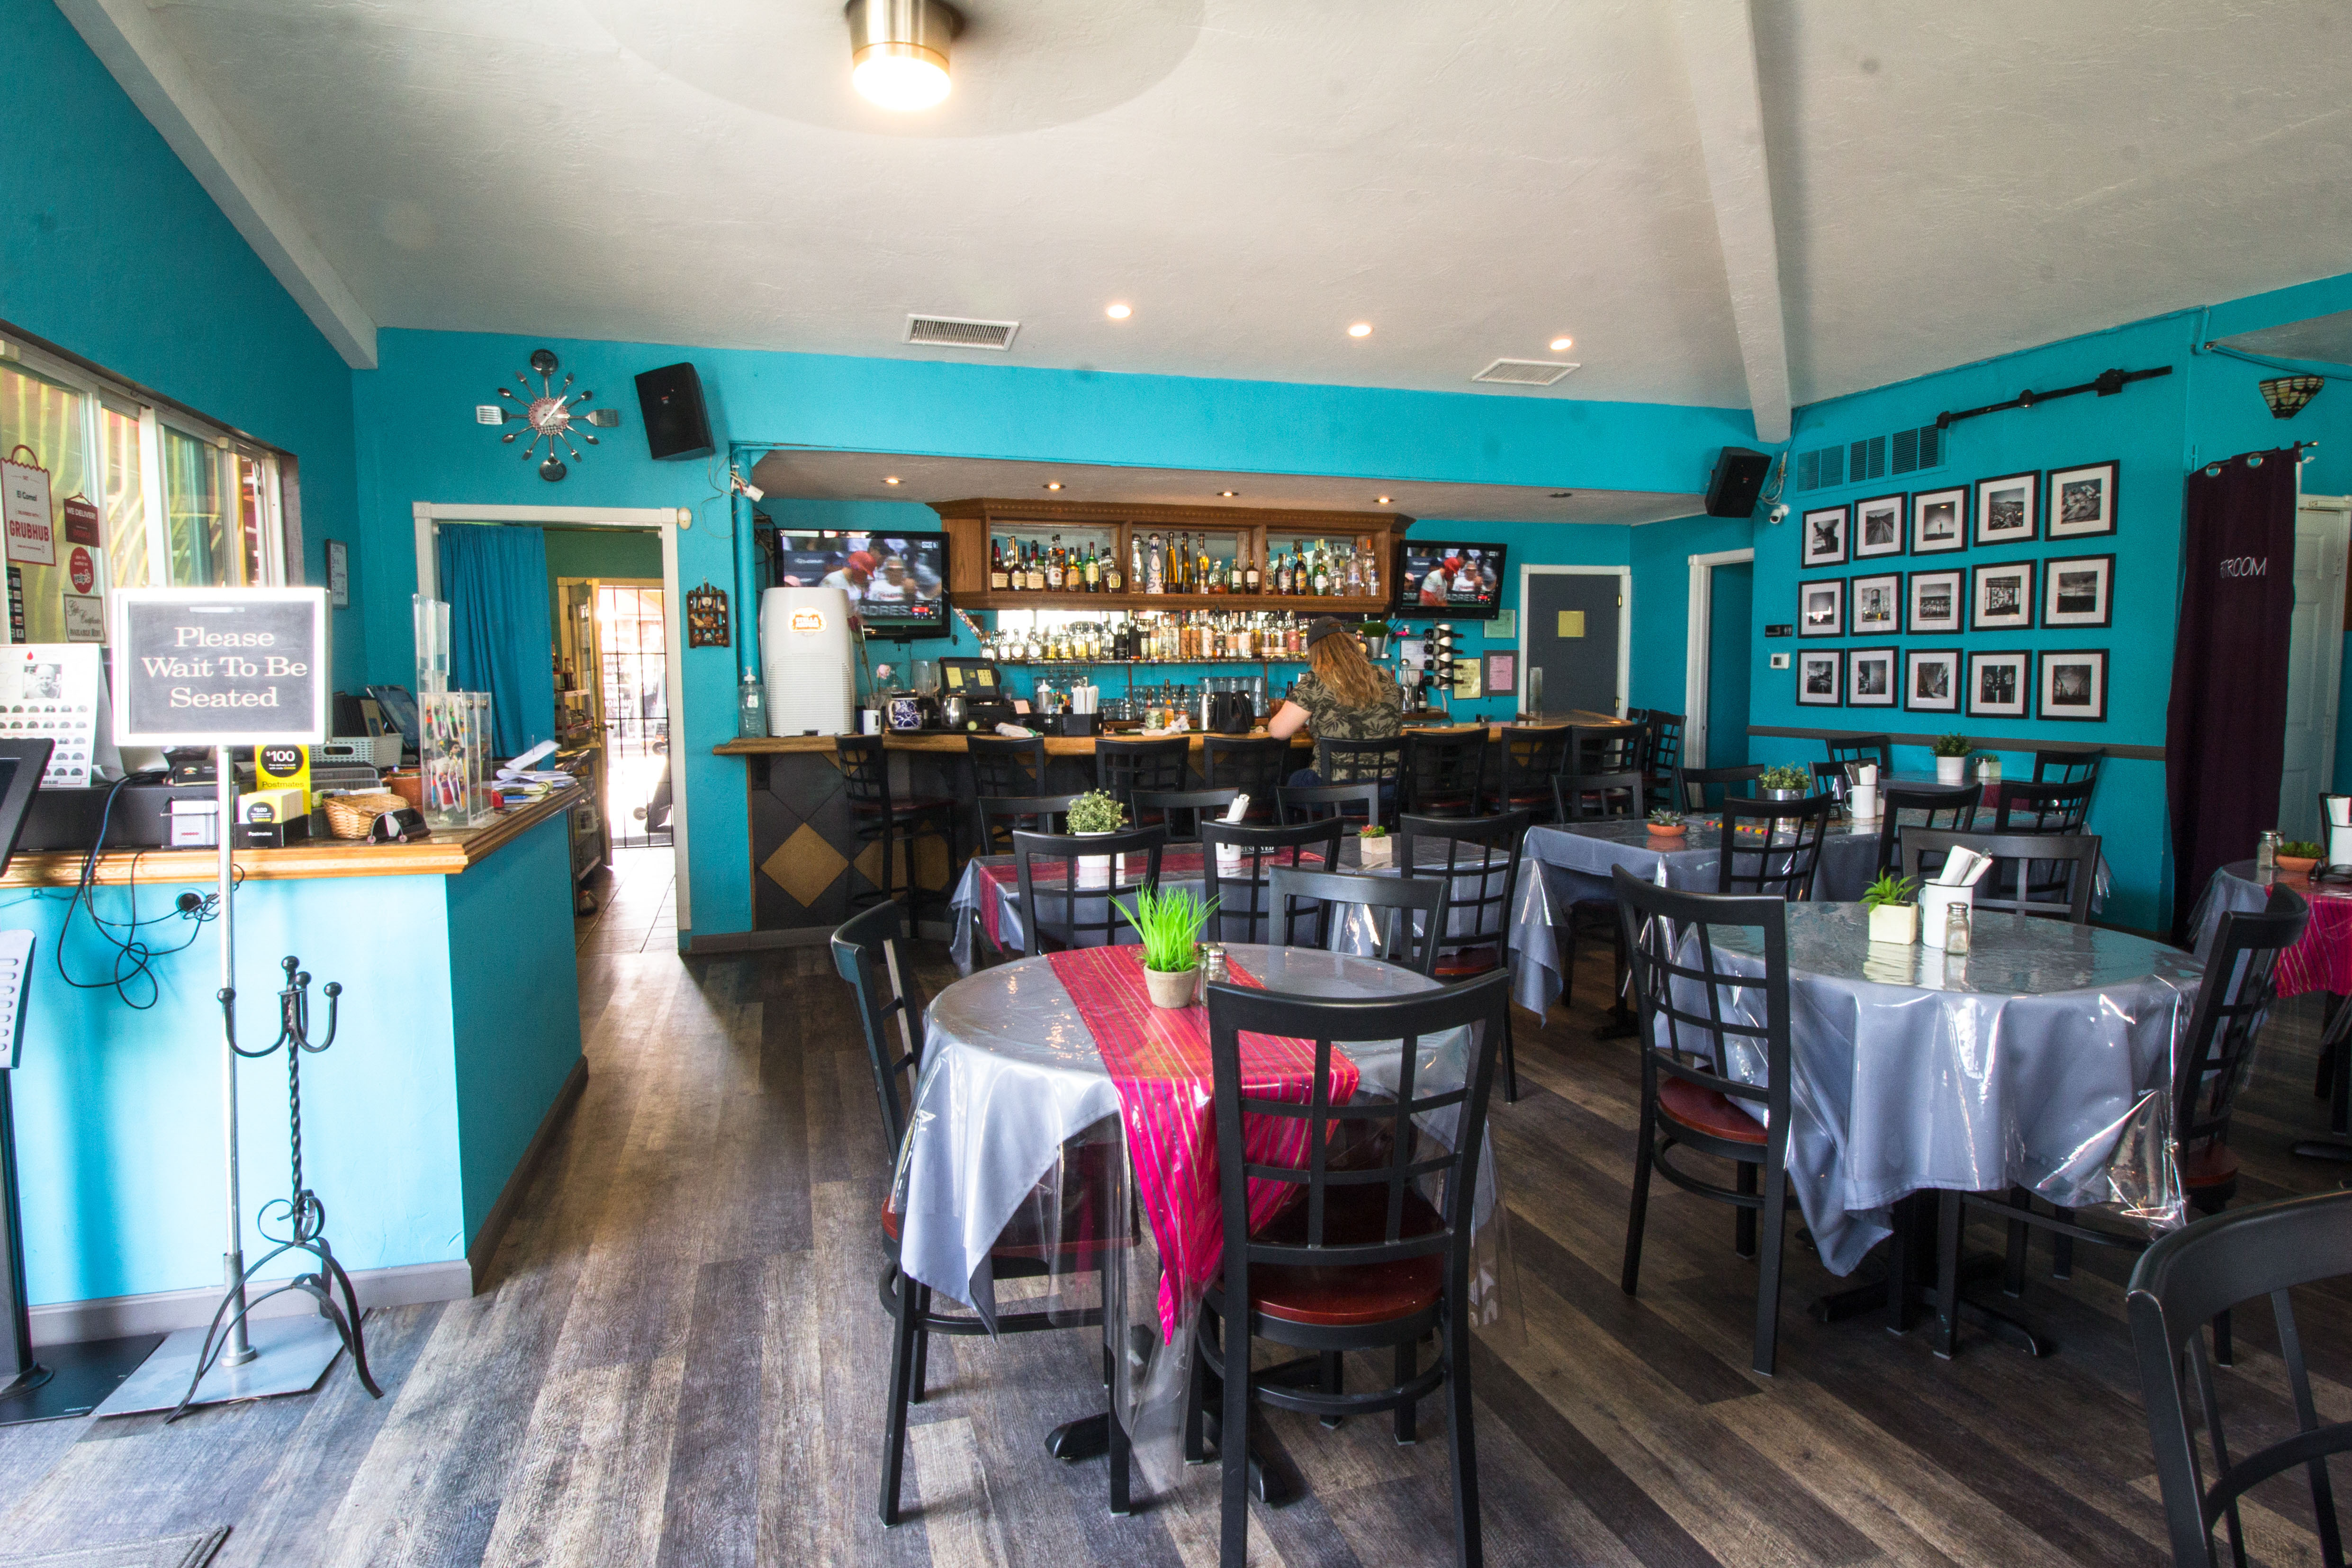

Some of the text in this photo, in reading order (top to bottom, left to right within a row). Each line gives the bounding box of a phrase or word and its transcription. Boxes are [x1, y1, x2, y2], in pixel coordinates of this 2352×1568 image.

[66, 507, 75, 515] WE
[9, 520, 50, 542] GRUBHUB
[174, 627, 275, 647] Please
[141, 656, 308, 677] Wait To Be
[170, 686, 280, 708] Seated
[266, 750, 296, 762] $100
